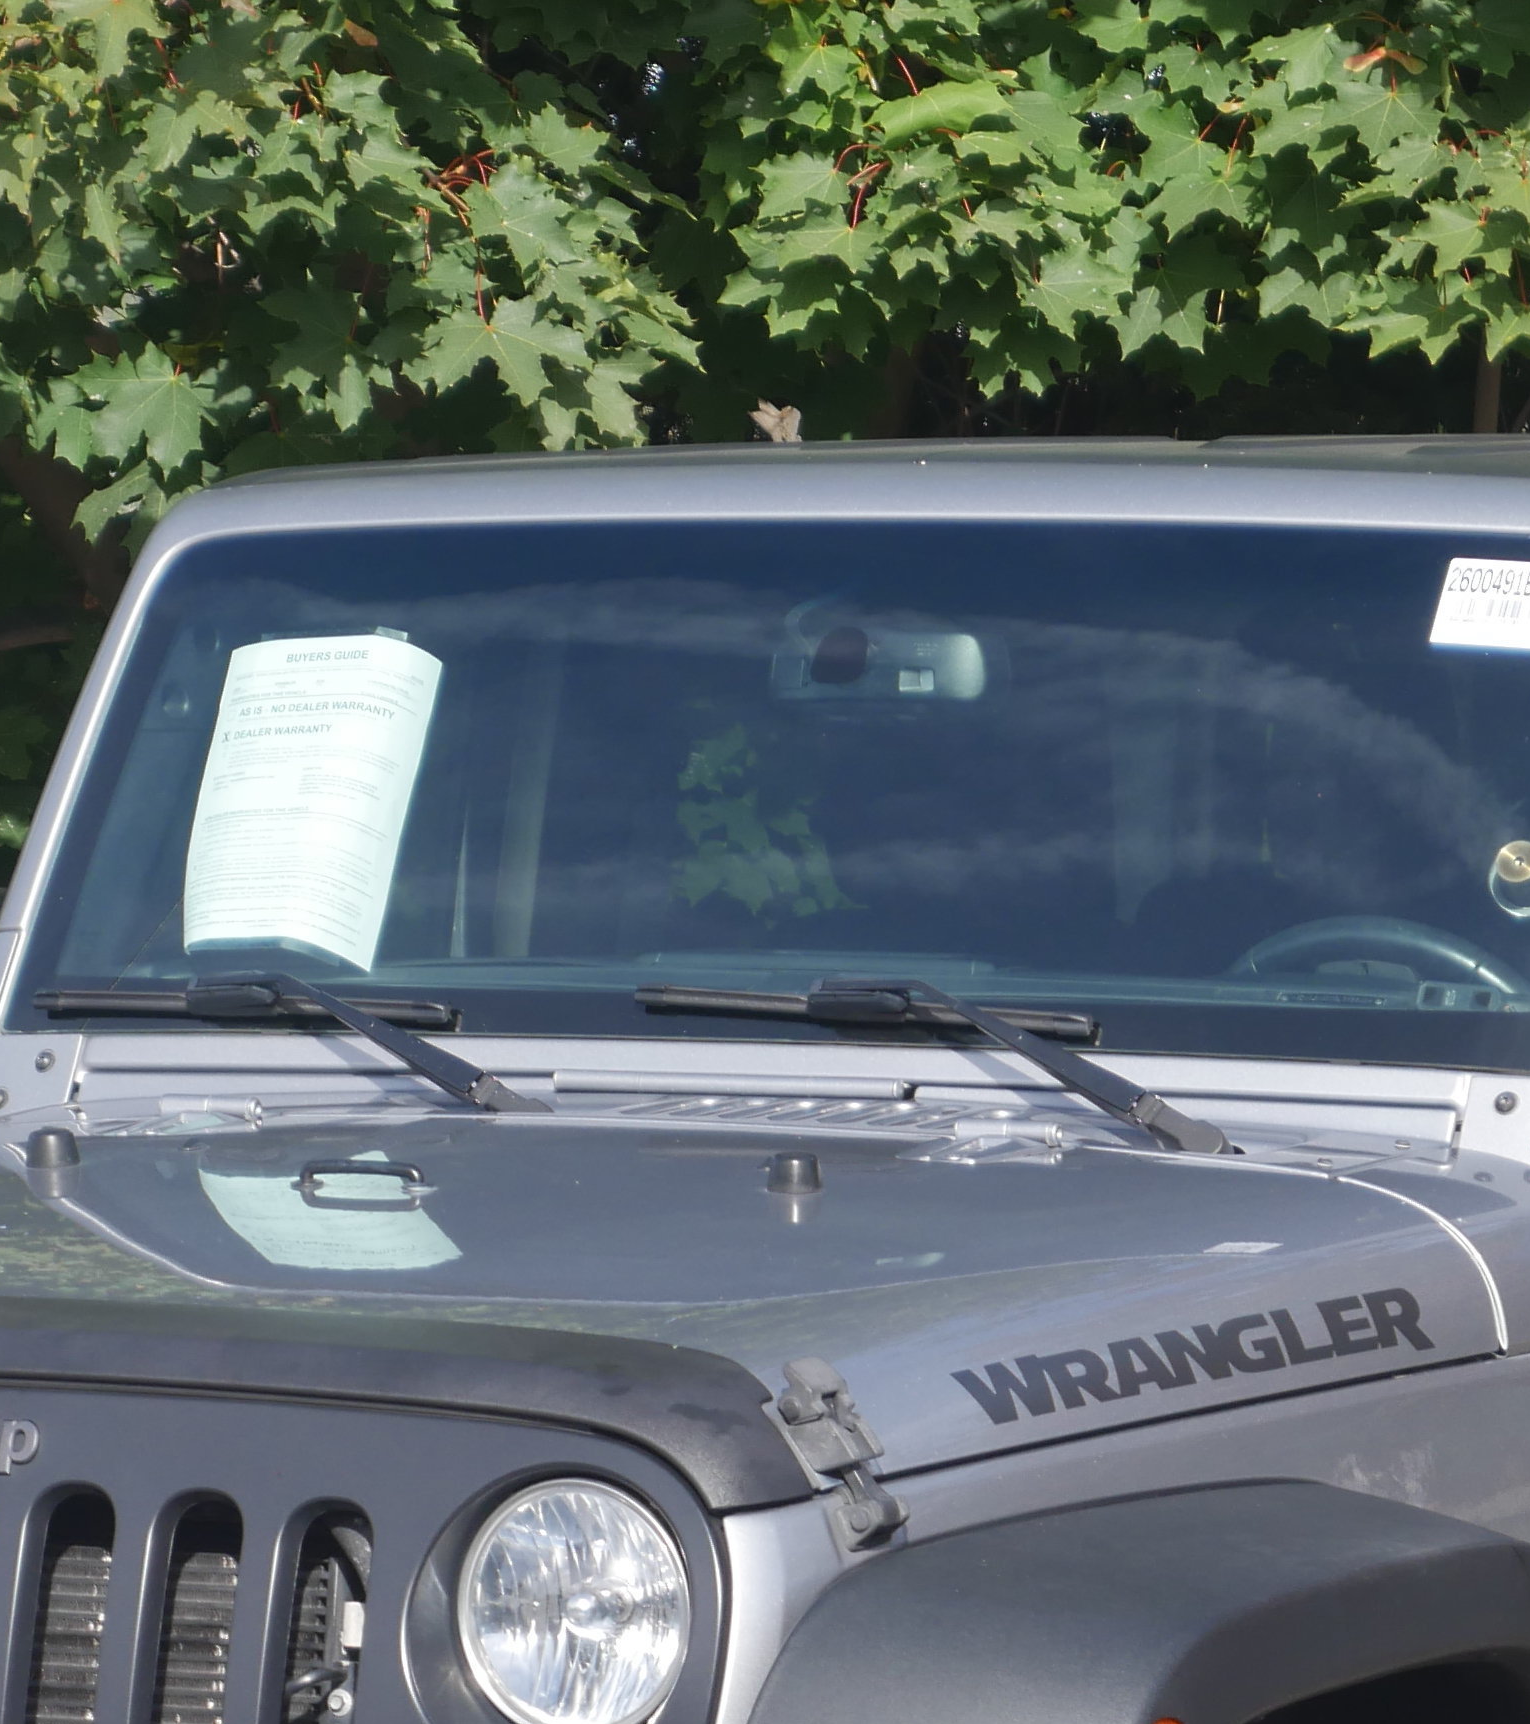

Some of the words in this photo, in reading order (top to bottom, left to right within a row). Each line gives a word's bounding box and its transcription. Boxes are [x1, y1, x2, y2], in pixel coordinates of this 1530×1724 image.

[286, 651, 331, 663] BUYERS
[334, 650, 369, 661] GUIDE
[239, 706, 252, 717] AS
[253, 705, 263, 715] IS
[270, 704, 286, 714] NO
[288, 702, 329, 713] DEALER
[332, 701, 395, 720] WARRANTY
[233, 728, 272, 740] DEALER
[273, 724, 333, 735] WARRANTY
[950, 1287, 1435, 1425] WRANGLER
